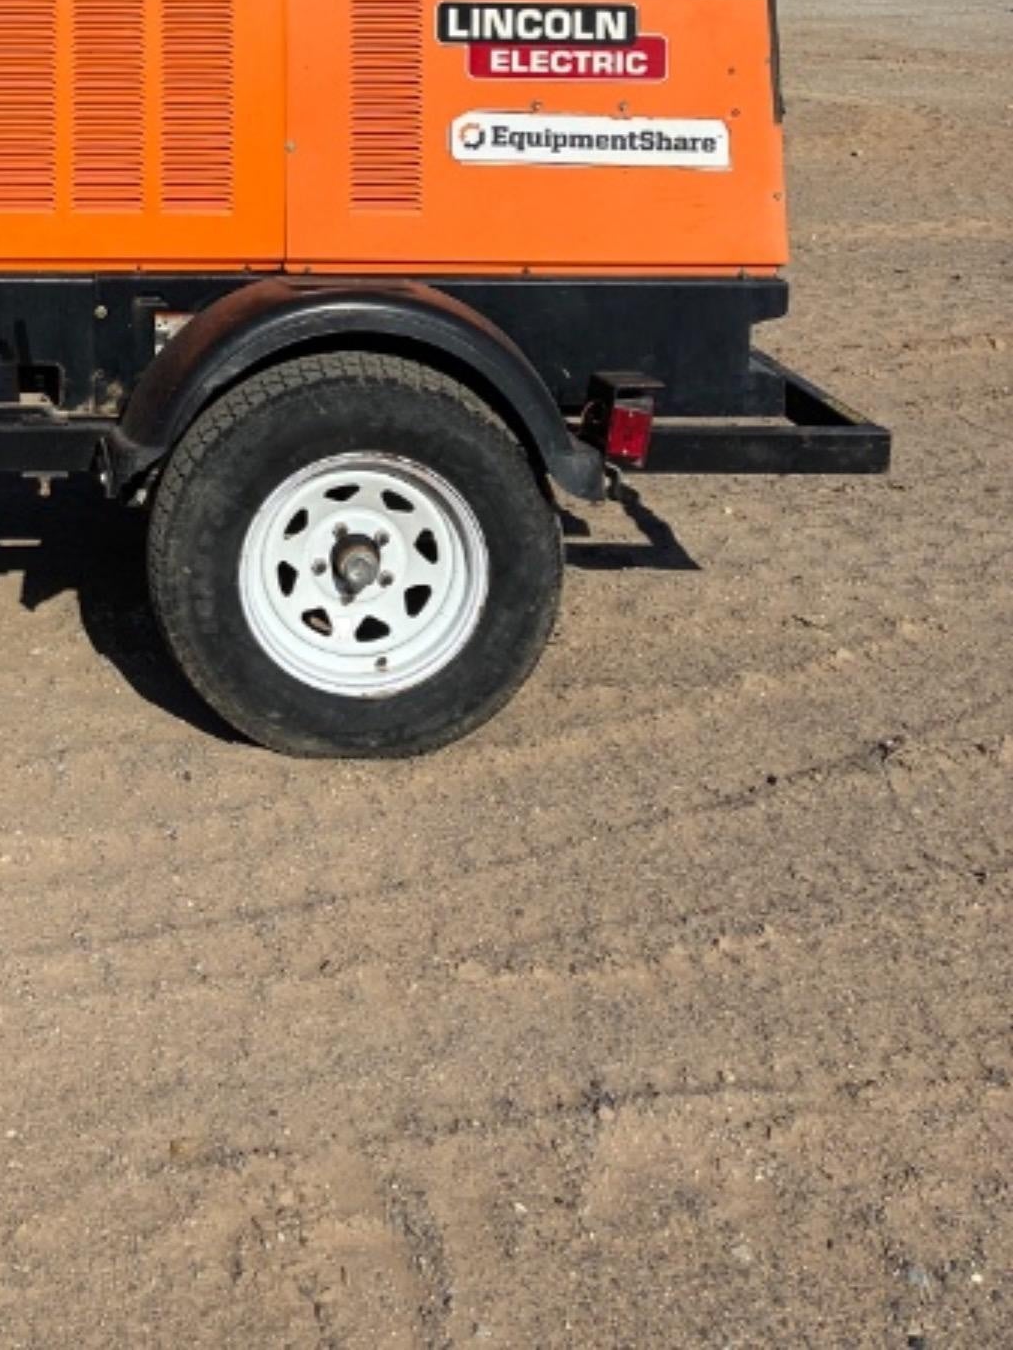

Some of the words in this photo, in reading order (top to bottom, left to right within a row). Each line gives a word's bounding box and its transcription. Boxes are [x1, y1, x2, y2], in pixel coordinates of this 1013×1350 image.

[447, 7, 628, 40] LINCOLN
[490, 49, 648, 74] ELECTRIC
[490, 125, 718, 153] EquipmentShare
